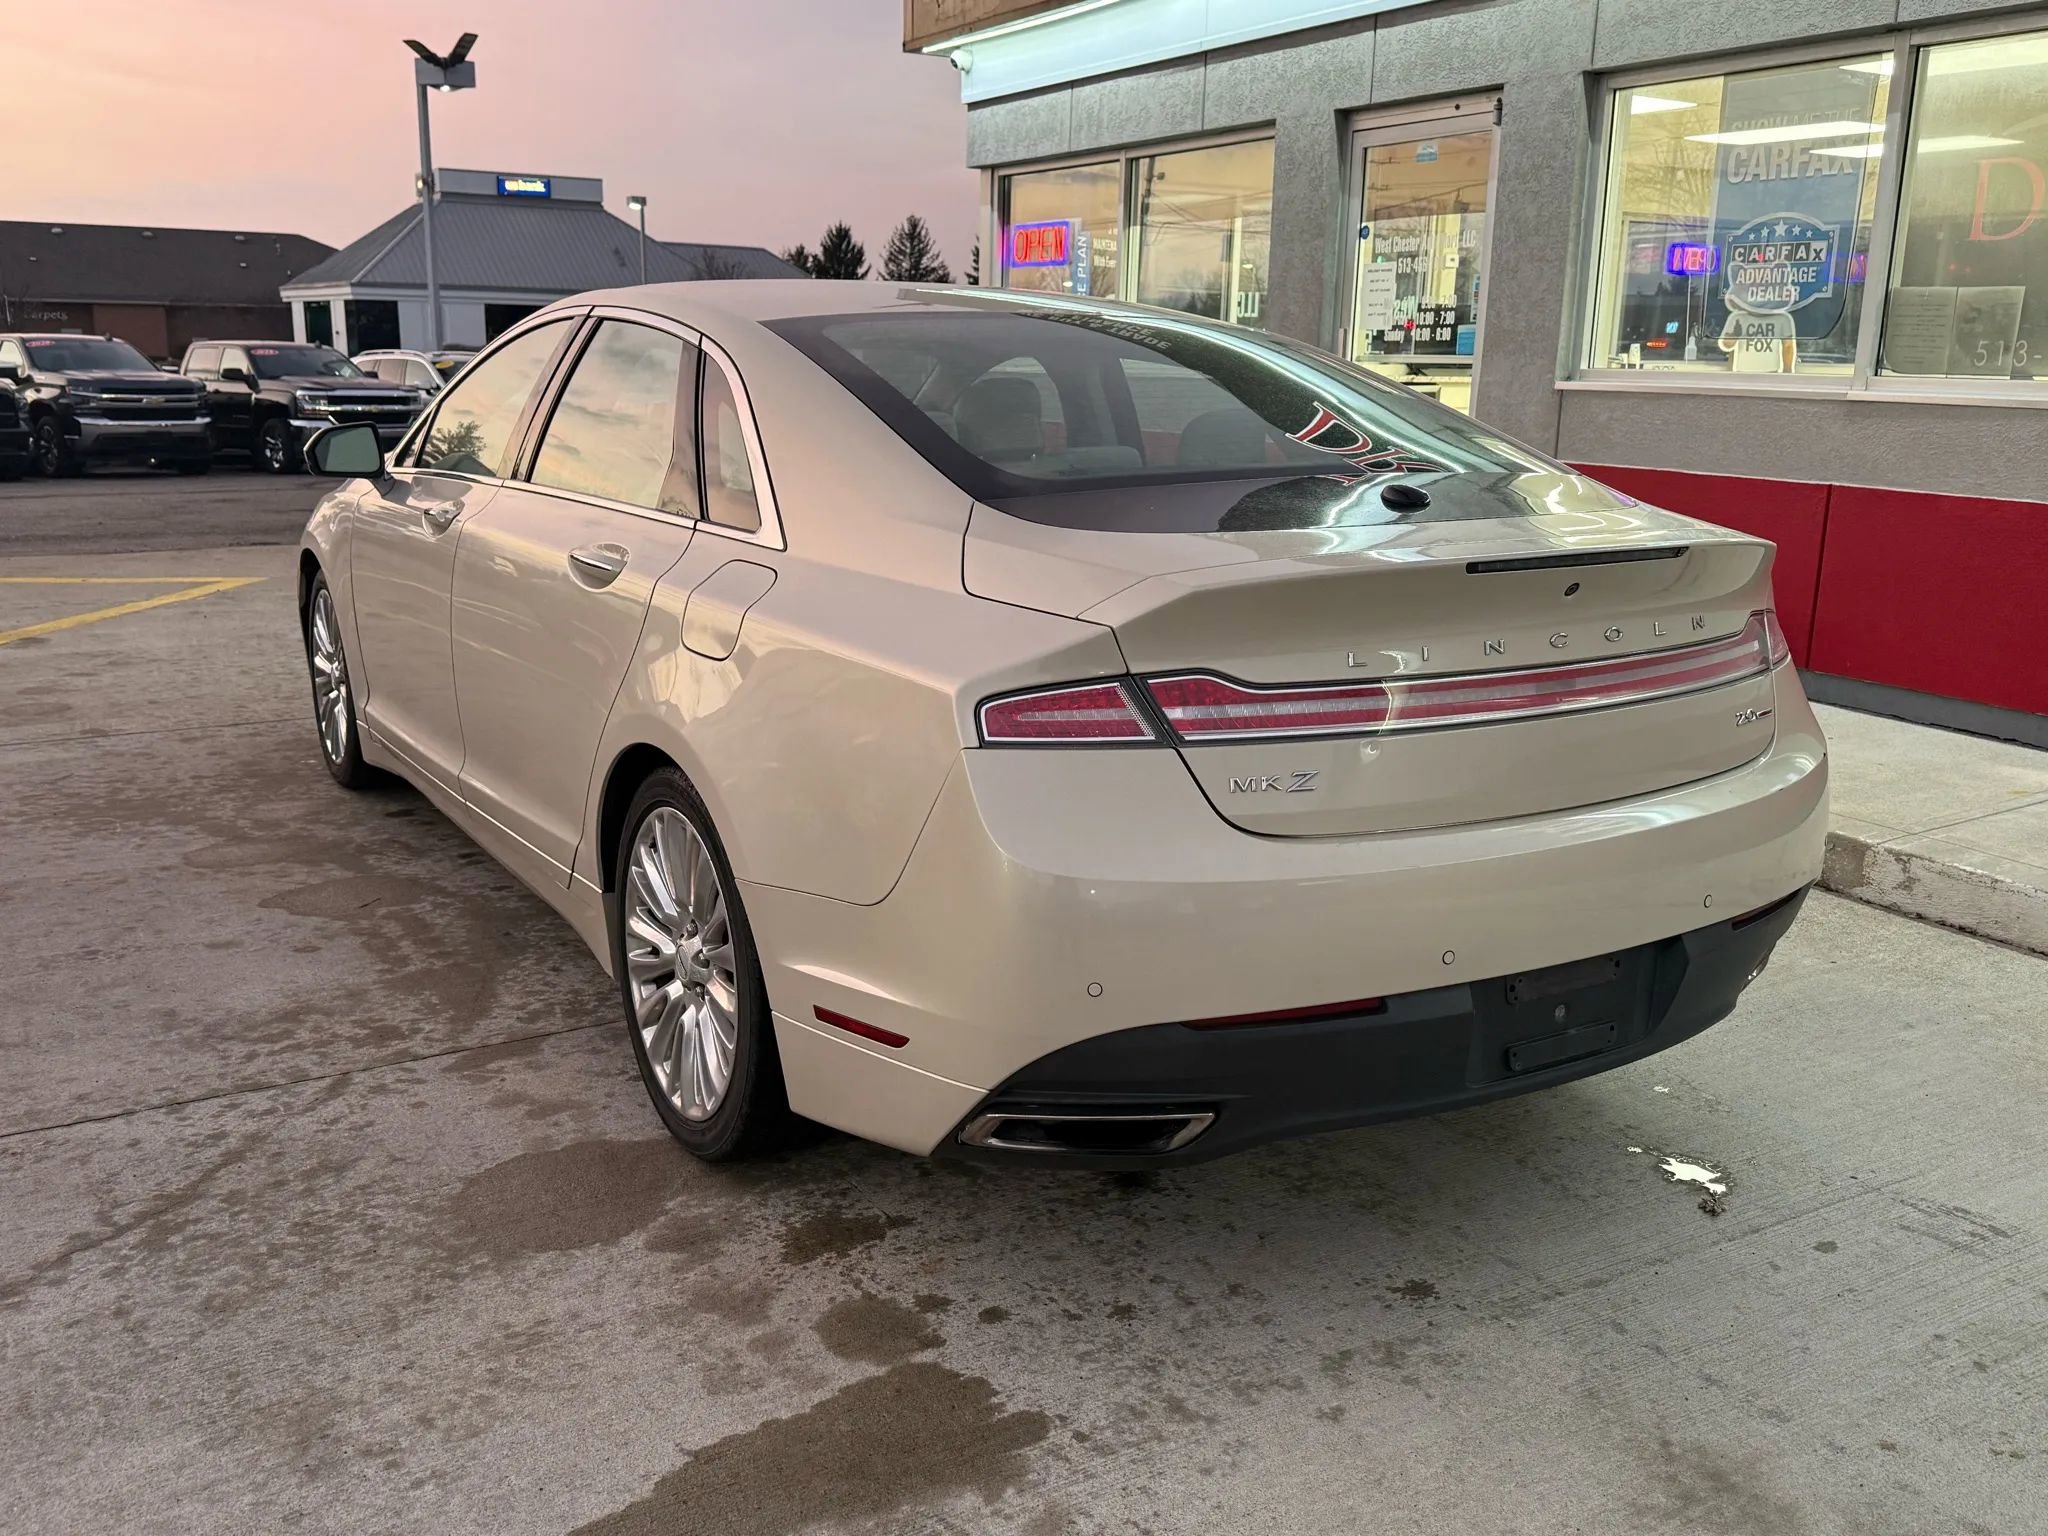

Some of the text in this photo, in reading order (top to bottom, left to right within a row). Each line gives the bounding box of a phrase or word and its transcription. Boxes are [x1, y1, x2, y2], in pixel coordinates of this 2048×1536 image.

[1727, 137, 1854, 184] CARFAX
[1013, 226, 1066, 263] OPEN
[1375, 236, 1392, 254] West
[1393, 235, 1420, 252] Chester
[1733, 244, 1825, 263] CARFAX
[1078, 236, 1088, 278] PLAN
[1736, 266, 1818, 285] ADVANTAGE
[1747, 285, 1800, 302] DEALER
[1440, 311, 1455, 325] 7:00
[1384, 328, 1405, 343] Sunday
[1746, 322, 1775, 337] CAR
[1746, 338, 1773, 353] FOX
[1347, 615, 1705, 668] LINCOLN
